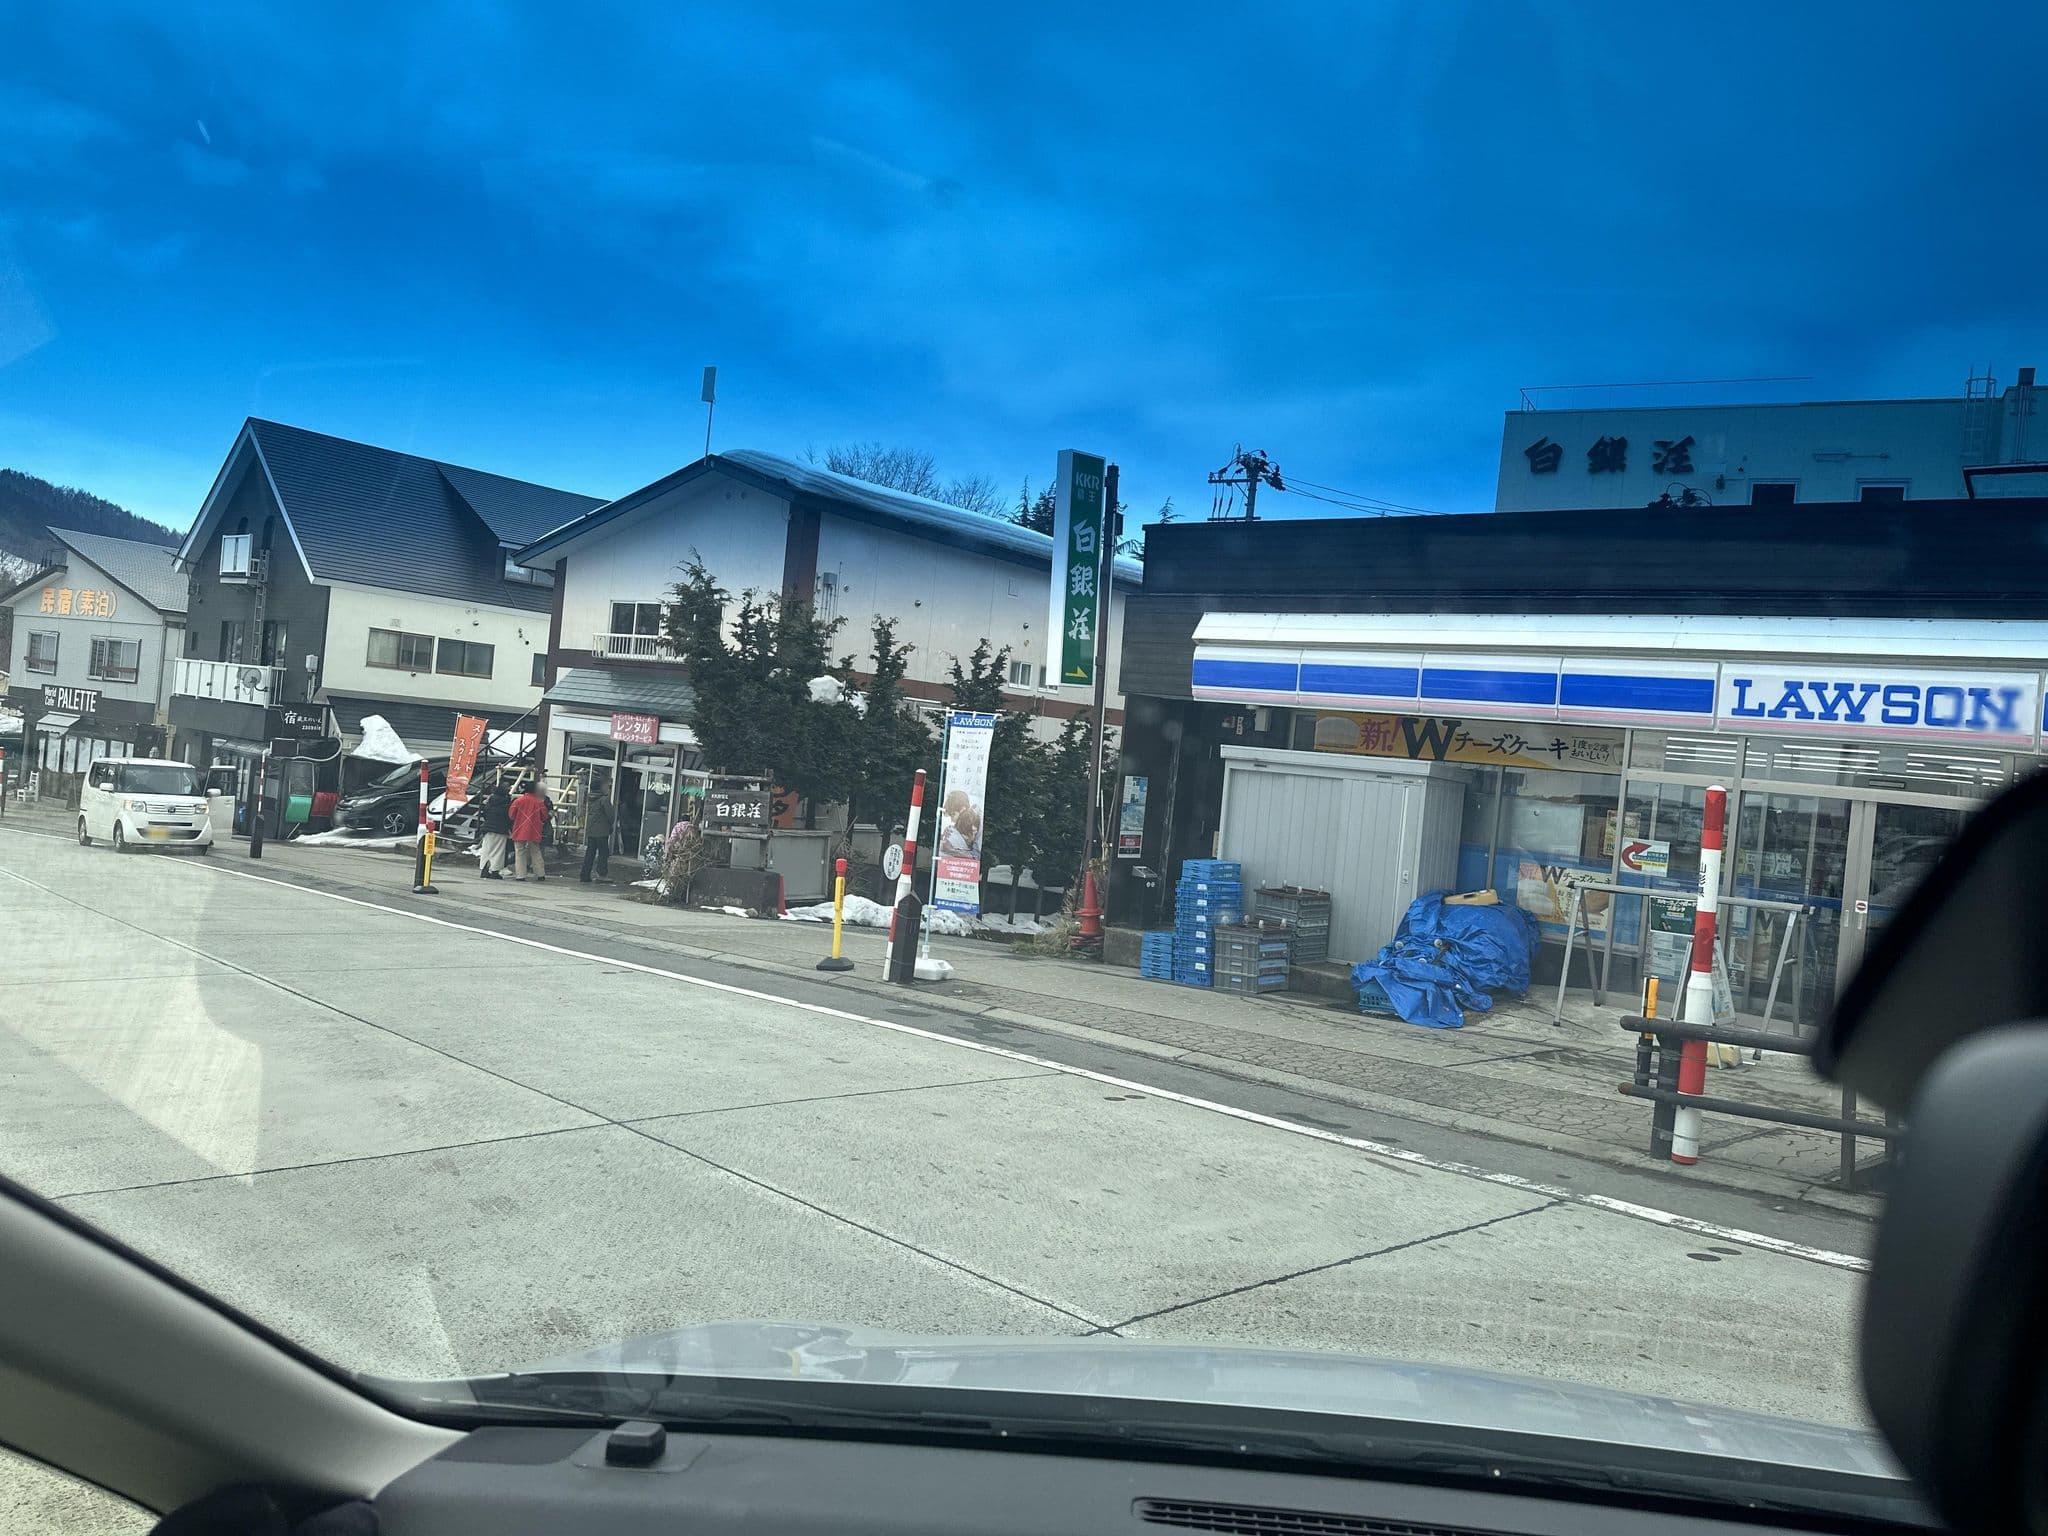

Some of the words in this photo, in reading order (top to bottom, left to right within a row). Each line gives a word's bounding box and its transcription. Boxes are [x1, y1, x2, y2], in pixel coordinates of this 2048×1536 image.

[1075, 471, 1100, 490] KKR
[1067, 518, 1096, 641] 白銀荘
[57, 687, 97, 713] PALETTE
[1731, 678, 2022, 730] LAWSON
[284, 710, 298, 725] 宿
[617, 720, 650, 734] レンタル
[953, 716, 993, 727] LAWSON
[454, 738, 466, 772] スクール
[716, 801, 762, 819] 白銀荘
